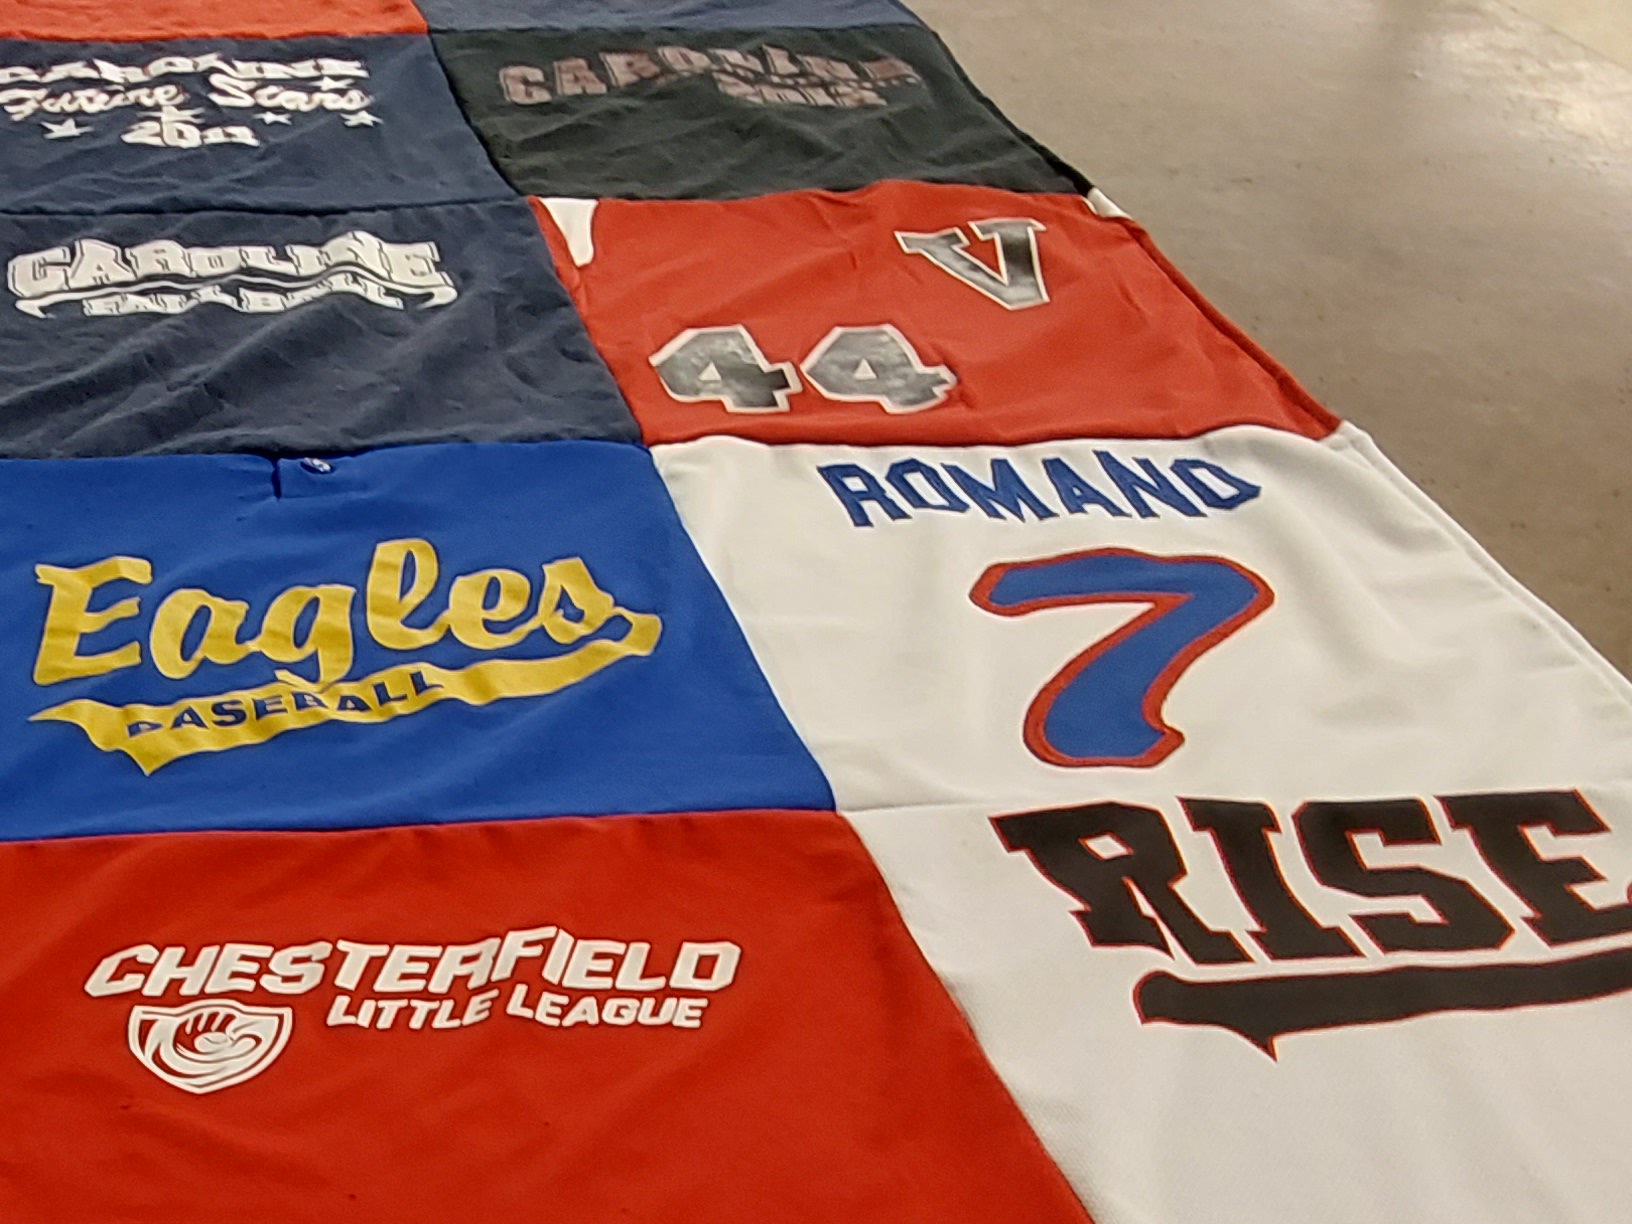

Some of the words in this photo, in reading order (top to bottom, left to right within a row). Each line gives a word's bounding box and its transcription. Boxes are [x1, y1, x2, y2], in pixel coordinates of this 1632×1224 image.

[119, 120, 261, 149] 2011
[7, 229, 454, 299] CAROLINE
[81, 284, 242, 317] FALL
[238, 272, 404, 314] BALL
[893, 216, 1051, 311] V
[648, 323, 958, 414] 44
[816, 448, 1262, 528] ROMANO
[33, 538, 628, 686] Eagles
[968, 546, 1276, 768] 7
[125, 670, 445, 739] BASEBALL
[988, 787, 1632, 965] RISE
[83, 925, 742, 999] CHESTERFIELD
[325, 988, 500, 1030] LITTLE
[505, 983, 709, 1030] LEAGUE
